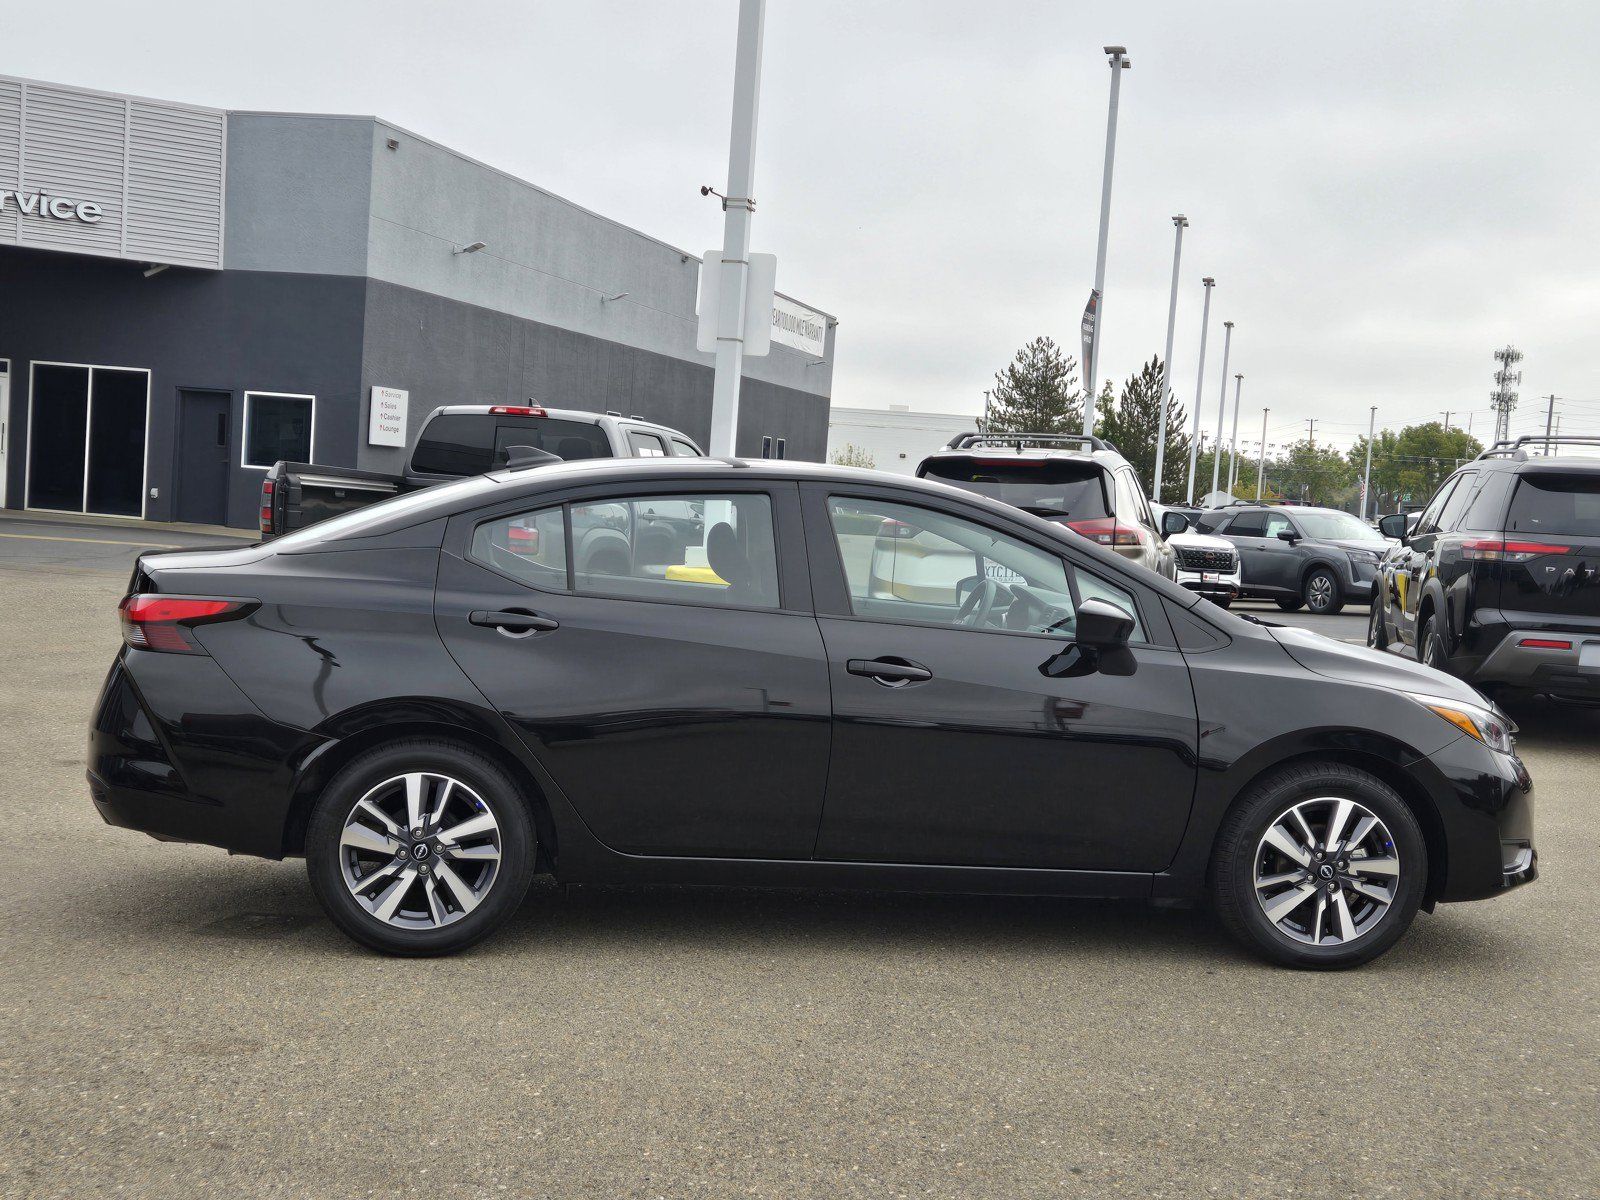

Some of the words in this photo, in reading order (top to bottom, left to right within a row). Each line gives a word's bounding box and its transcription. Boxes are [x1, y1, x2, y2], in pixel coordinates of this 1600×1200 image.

[0, 188, 102, 222] rvice
[385, 390, 401, 399] Service
[384, 402, 397, 410] Sales
[383, 413, 401, 421] Cashier
[383, 424, 400, 433] Lounge
[1545, 566, 1595, 577] PAT
